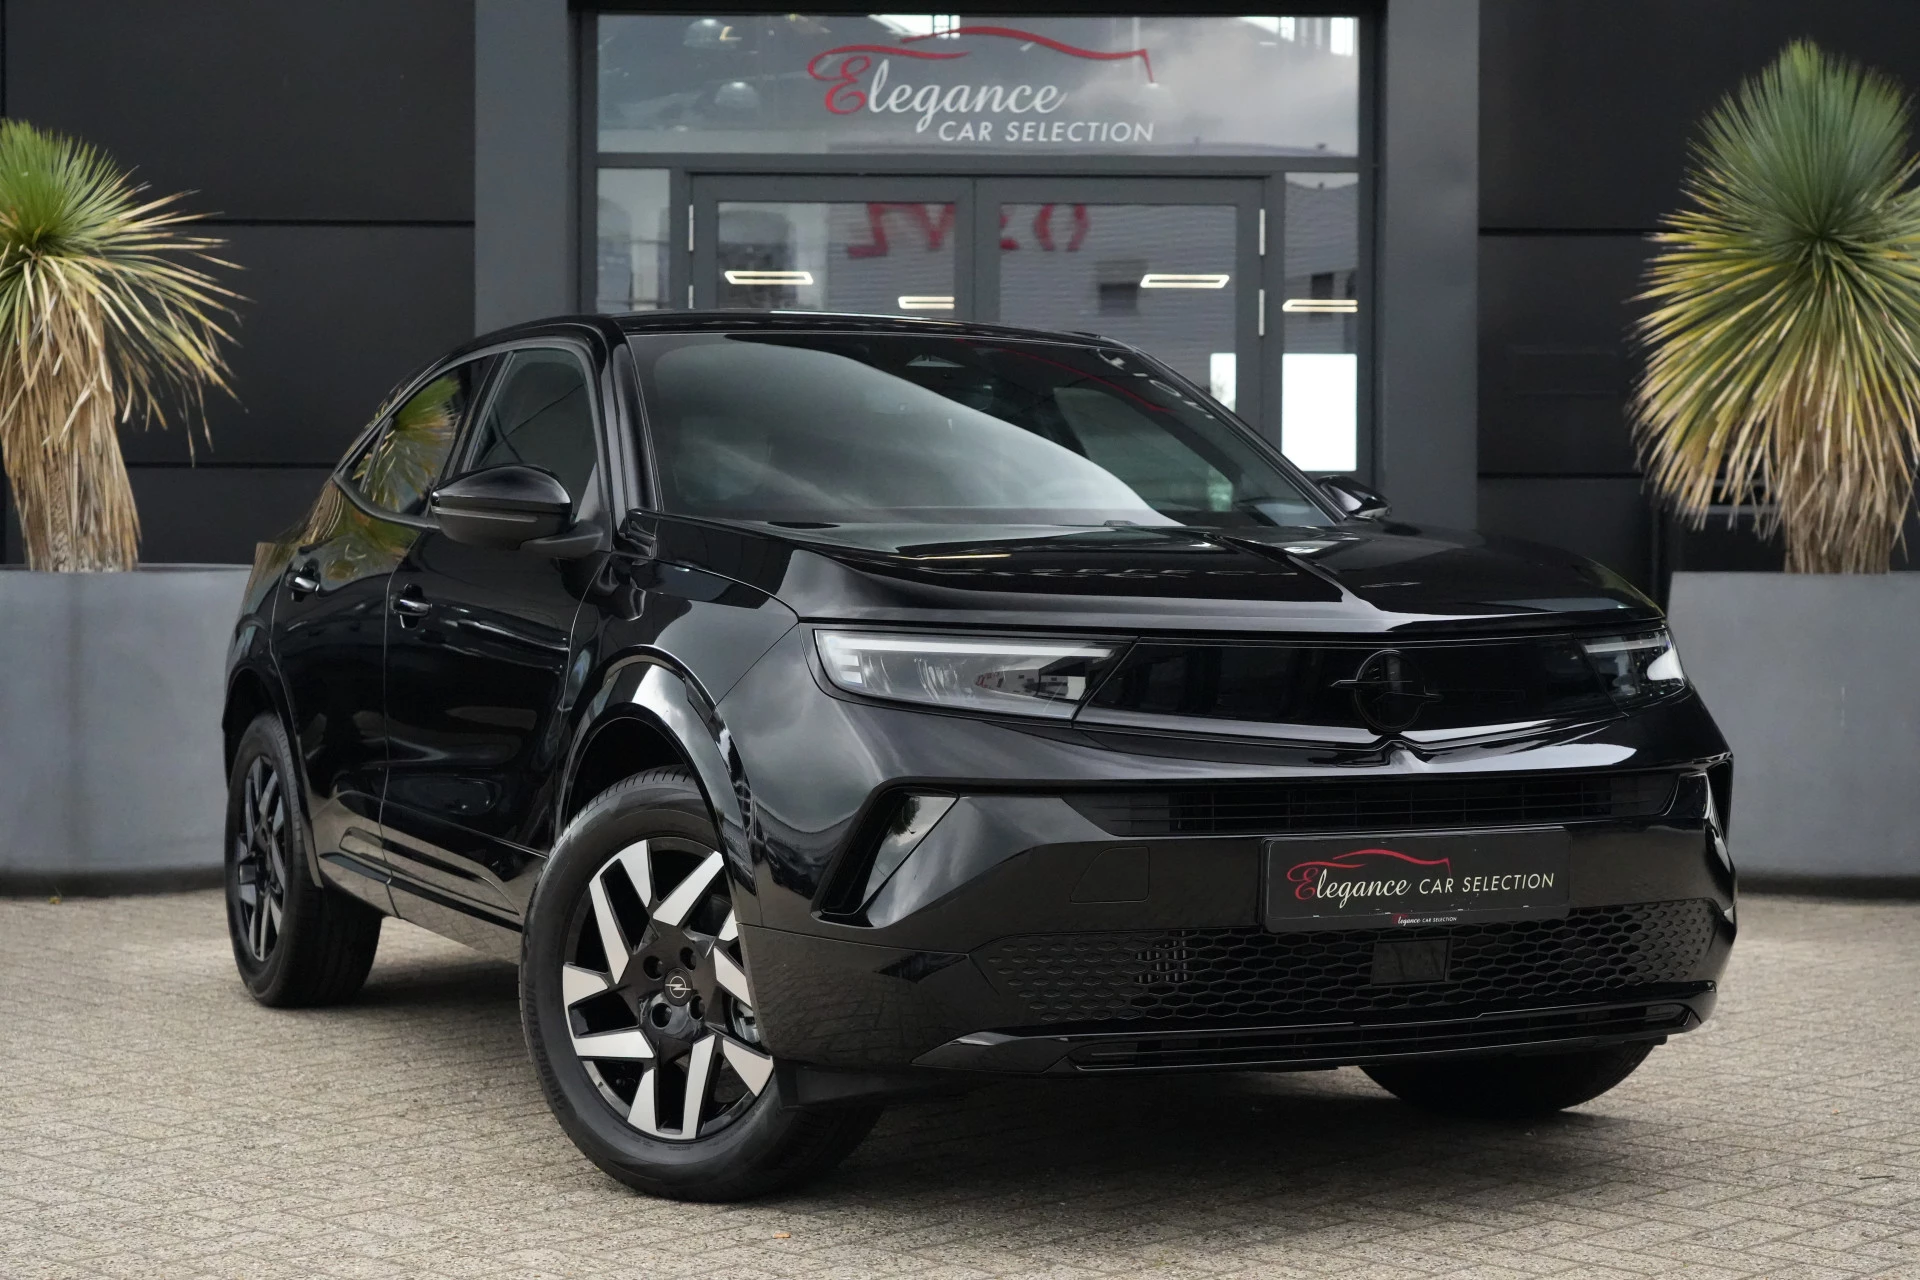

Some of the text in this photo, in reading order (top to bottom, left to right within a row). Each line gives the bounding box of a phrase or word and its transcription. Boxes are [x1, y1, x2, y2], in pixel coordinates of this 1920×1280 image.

[807, 45, 1067, 132] Elegance
[938, 121, 1154, 142] CAR SELECTION
[1287, 862, 1555, 908] Elegance CAR SELECTION
